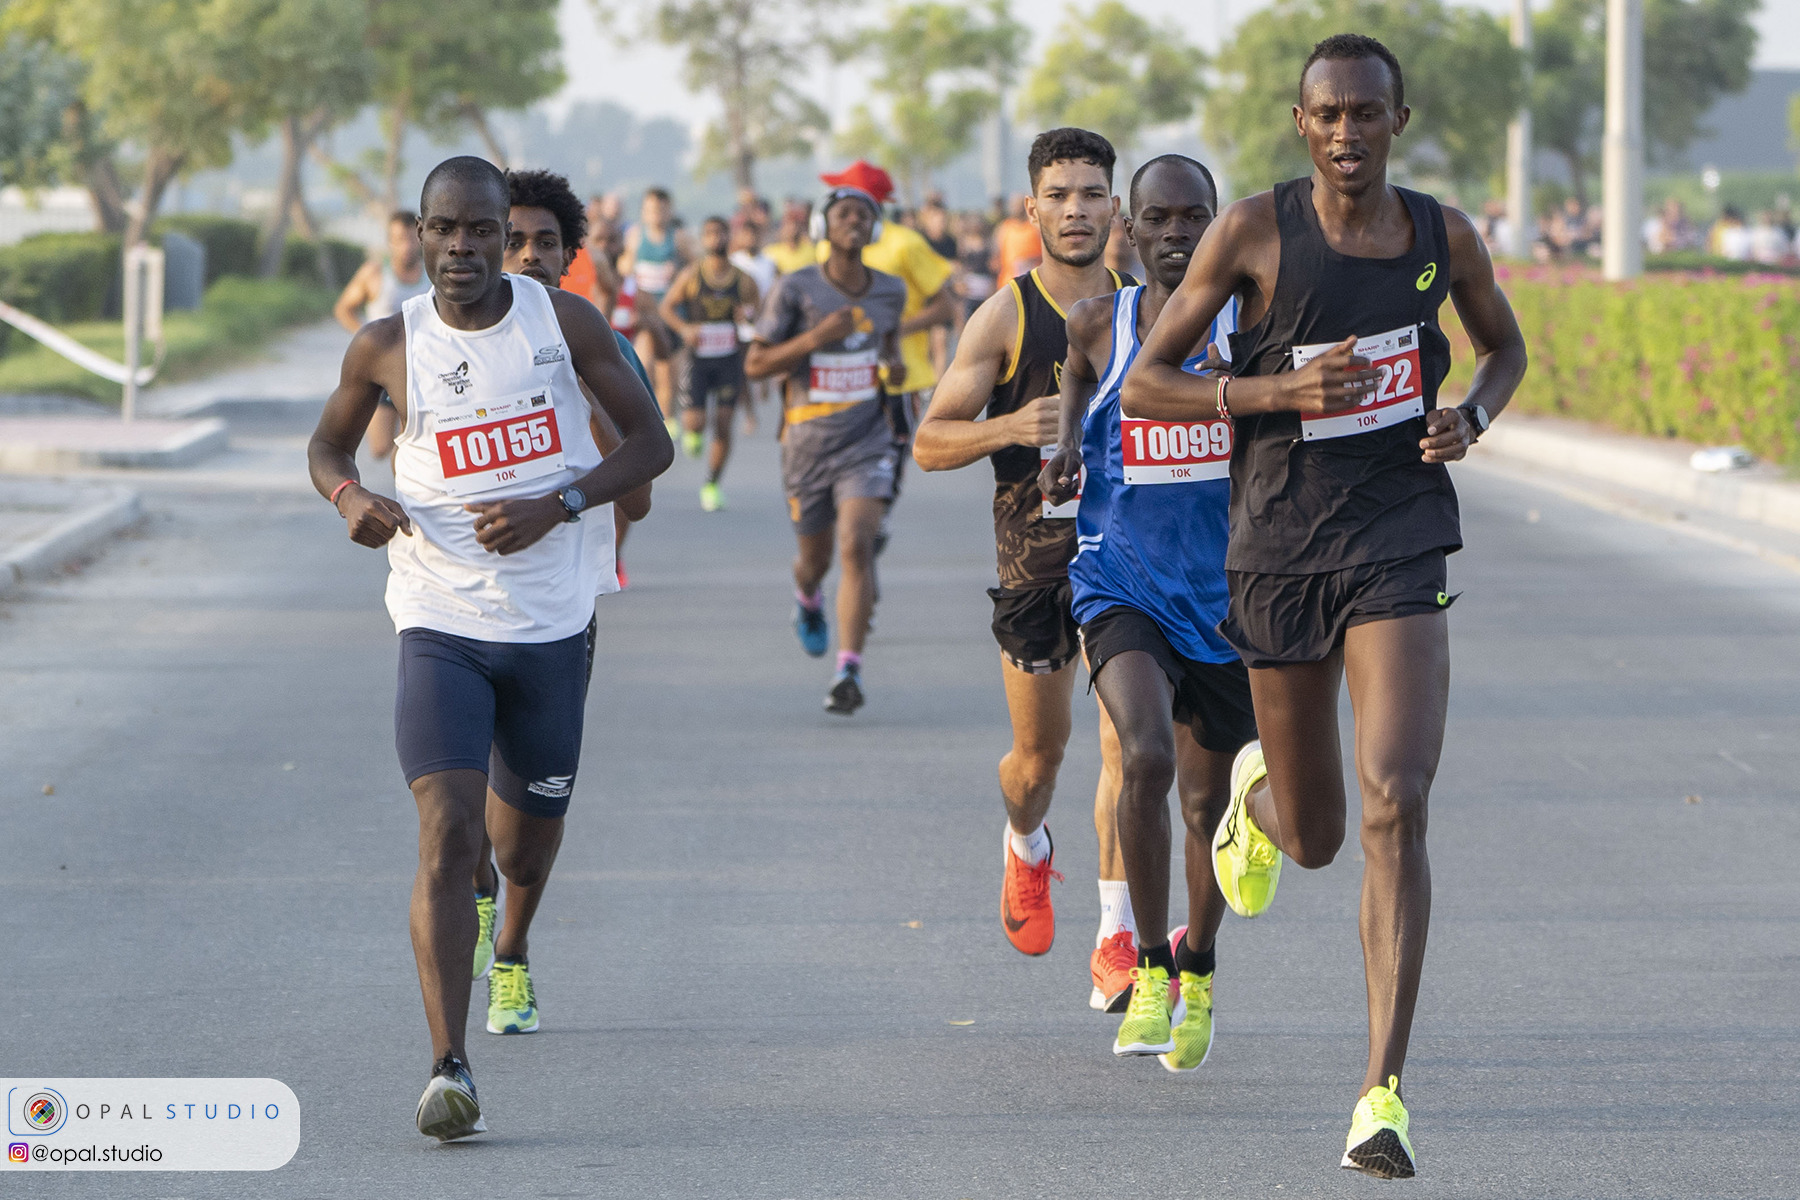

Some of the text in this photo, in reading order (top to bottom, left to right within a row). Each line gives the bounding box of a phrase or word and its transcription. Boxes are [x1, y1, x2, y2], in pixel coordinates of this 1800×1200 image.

[1357, 414, 1378, 427] 10K
[446, 416, 552, 471] 10155
[1129, 421, 1231, 461] 10099
[495, 469, 517, 482] 10K
[1170, 468, 1191, 478] 10K
